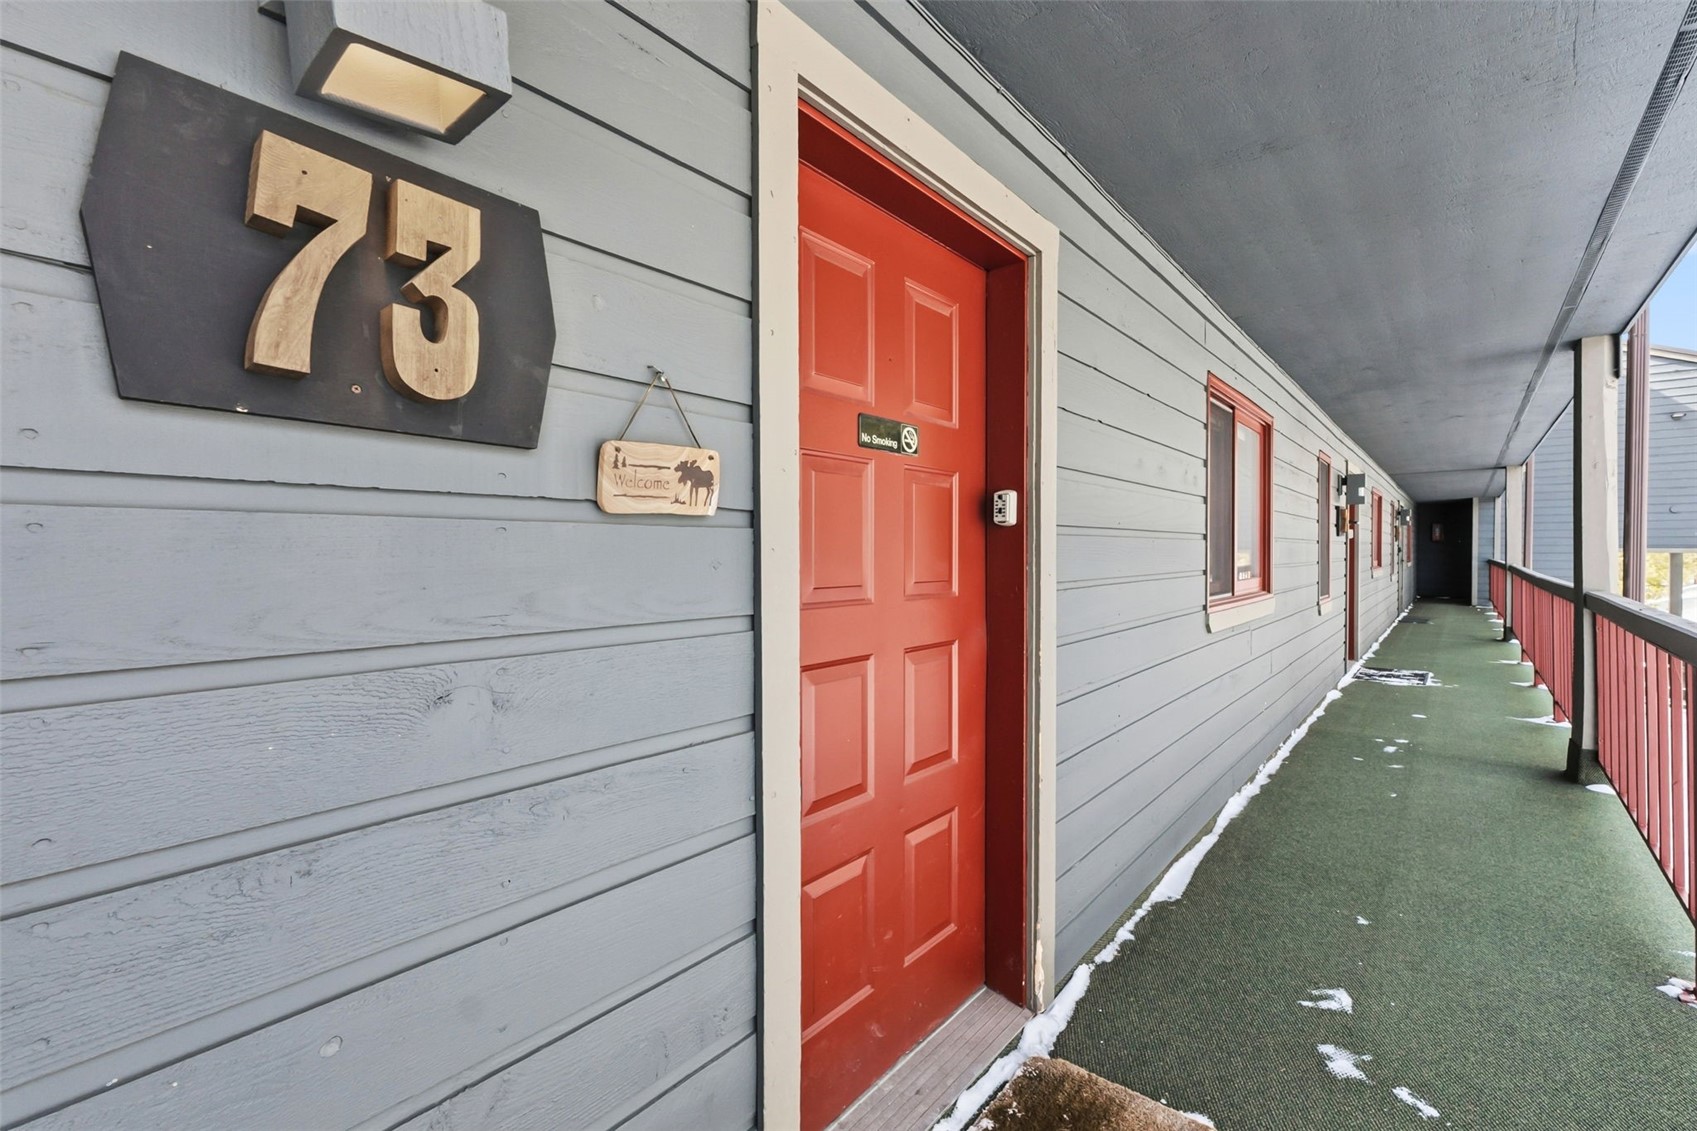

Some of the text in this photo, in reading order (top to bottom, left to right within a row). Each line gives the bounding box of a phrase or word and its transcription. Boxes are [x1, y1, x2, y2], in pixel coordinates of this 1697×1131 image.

[244, 129, 481, 402] 73
[861, 432, 898, 449] No Smoking
[613, 469, 670, 490] Welcome
